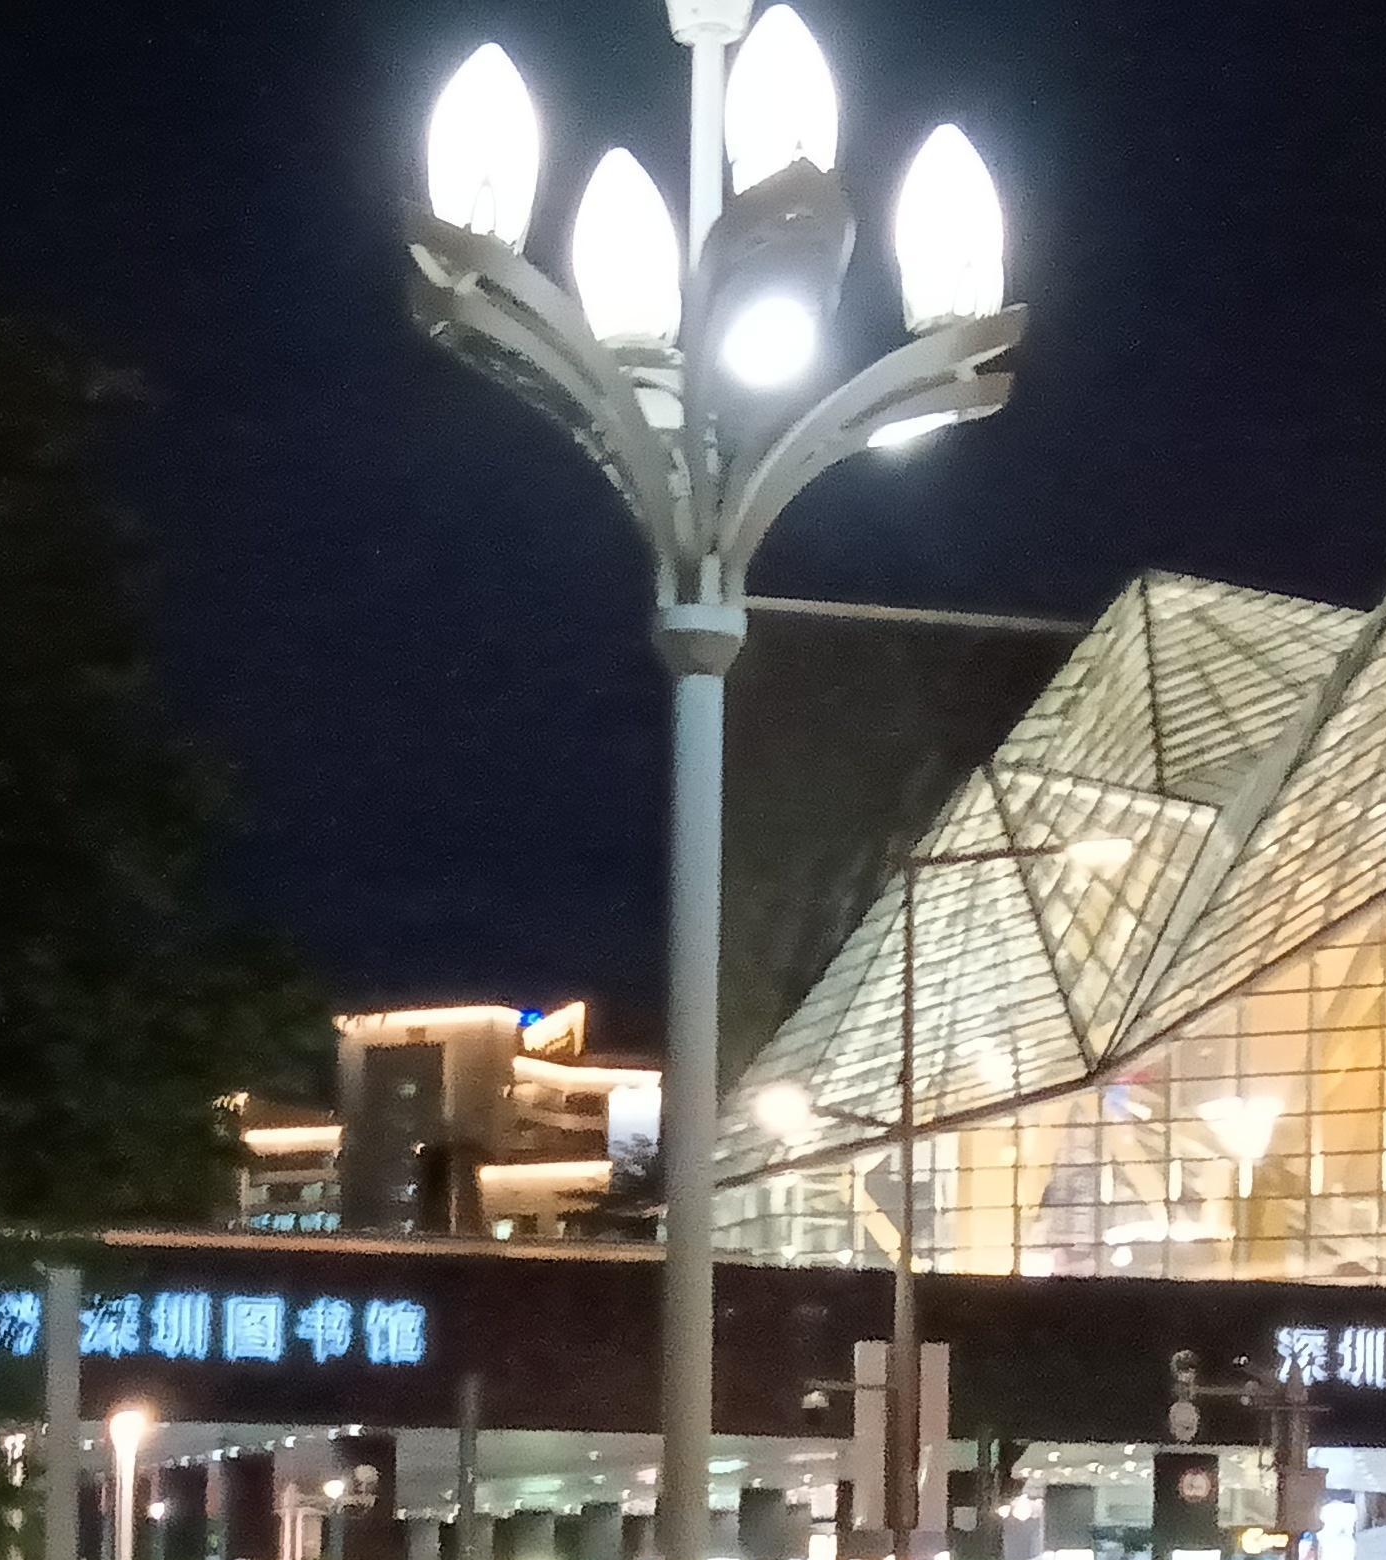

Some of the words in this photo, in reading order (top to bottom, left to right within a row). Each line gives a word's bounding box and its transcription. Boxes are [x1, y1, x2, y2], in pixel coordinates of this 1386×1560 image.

[79, 1292, 425, 1364] 深圳图书馆
